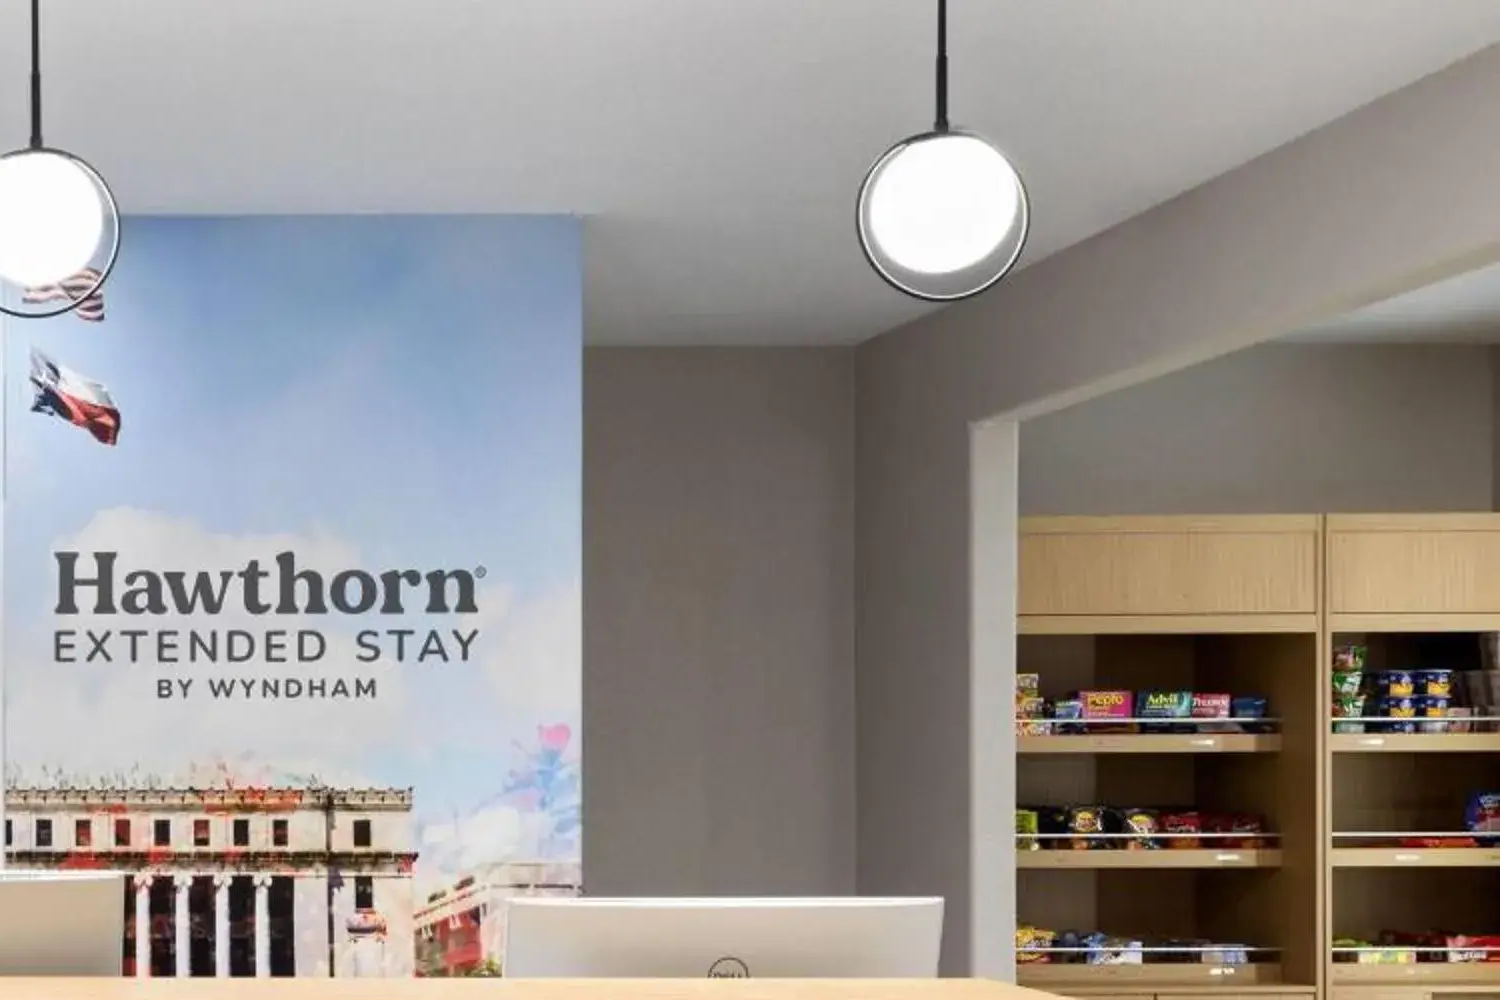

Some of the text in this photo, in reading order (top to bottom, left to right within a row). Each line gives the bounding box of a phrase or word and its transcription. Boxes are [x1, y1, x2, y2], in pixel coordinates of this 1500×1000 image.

[53, 550, 480, 615] Hawthorn
[53, 629, 480, 663] EXTENDED STAY
[156, 678, 377, 698] BY WYNDHAM
